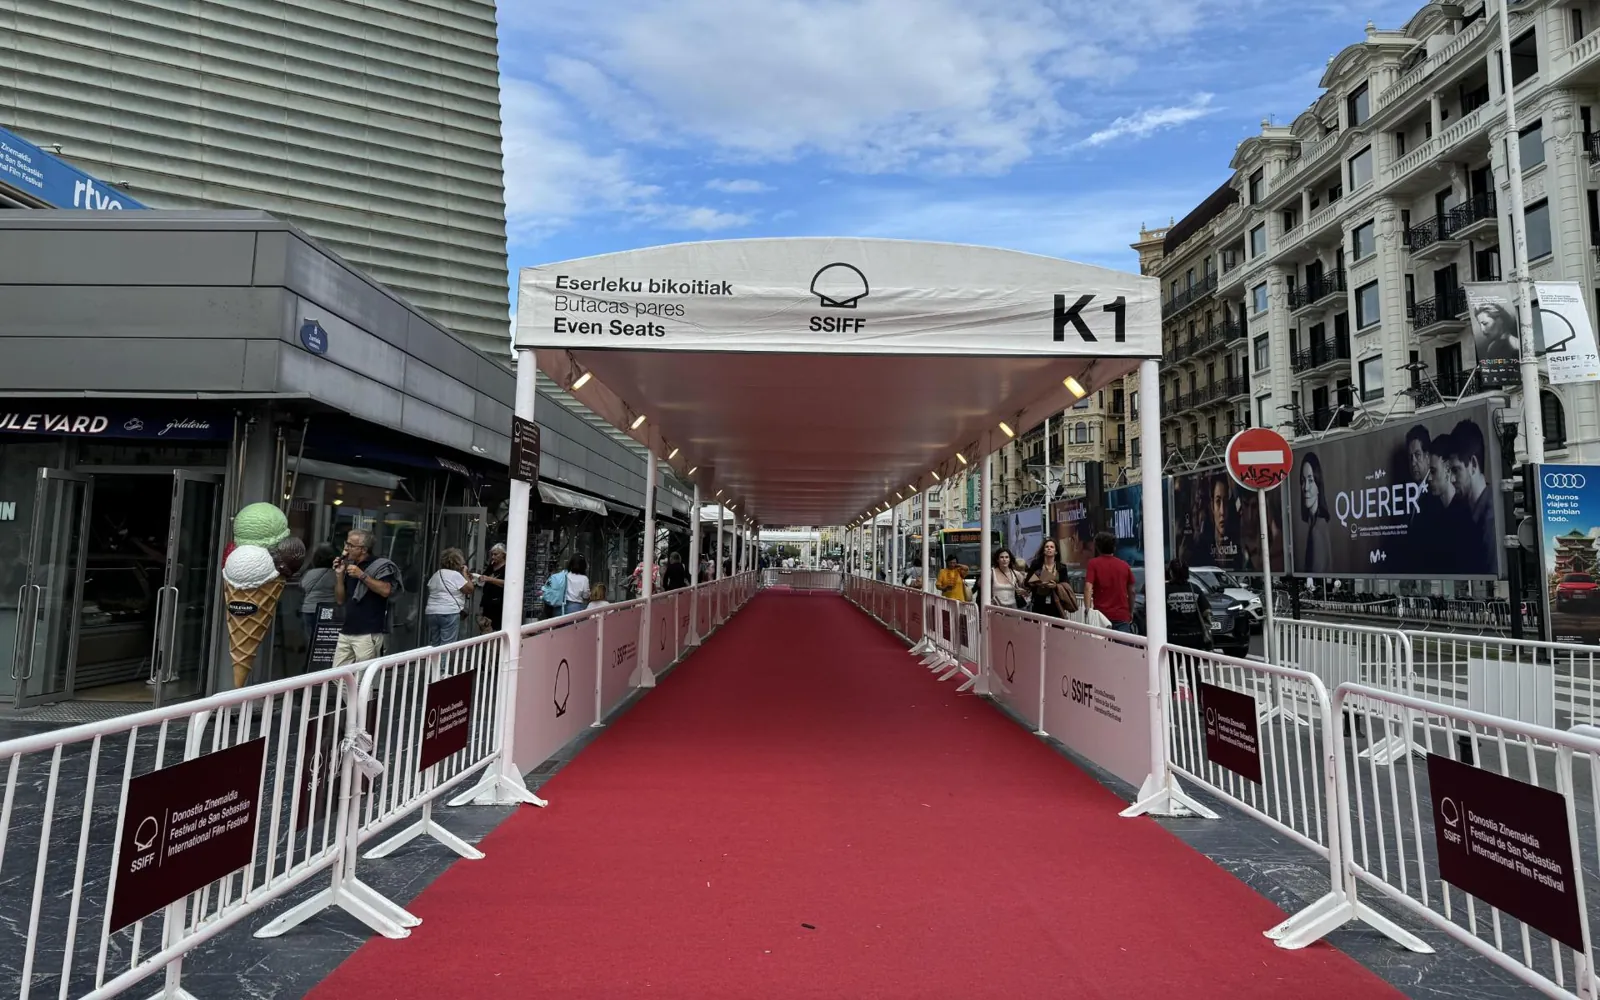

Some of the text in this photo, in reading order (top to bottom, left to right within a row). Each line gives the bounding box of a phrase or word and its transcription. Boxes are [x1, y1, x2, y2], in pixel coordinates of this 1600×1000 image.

[1, 142, 32, 163] Zinemaldia
[5, 154, 16, 166] San
[17, 161, 44, 180] Sebastián
[9, 166, 21, 178] Film
[22, 173, 42, 188] Festival
[556, 276, 732, 296] Eserleku bikoitiak
[555, 296, 684, 318] Butacas pares
[1053, 294, 1125, 342] K1
[554, 317, 666, 338] Even Seats
[809, 316, 866, 333] SSIFF
[1072, 678, 1092, 708] SSIFF
[170, 799, 250, 840] Festival de San Sebastián
[172, 790, 238, 824] Donostia Zinemaldia
[168, 812, 249, 857] International Film Festival
[1444, 829, 1461, 844] SSIFF
[1468, 810, 1540, 849] Donostia Zinemaldia
[130, 852, 155, 873] SSIFF
[1470, 825, 1562, 874] Festival de San Sebastián
[1472, 841, 1565, 893] International Film Festival
